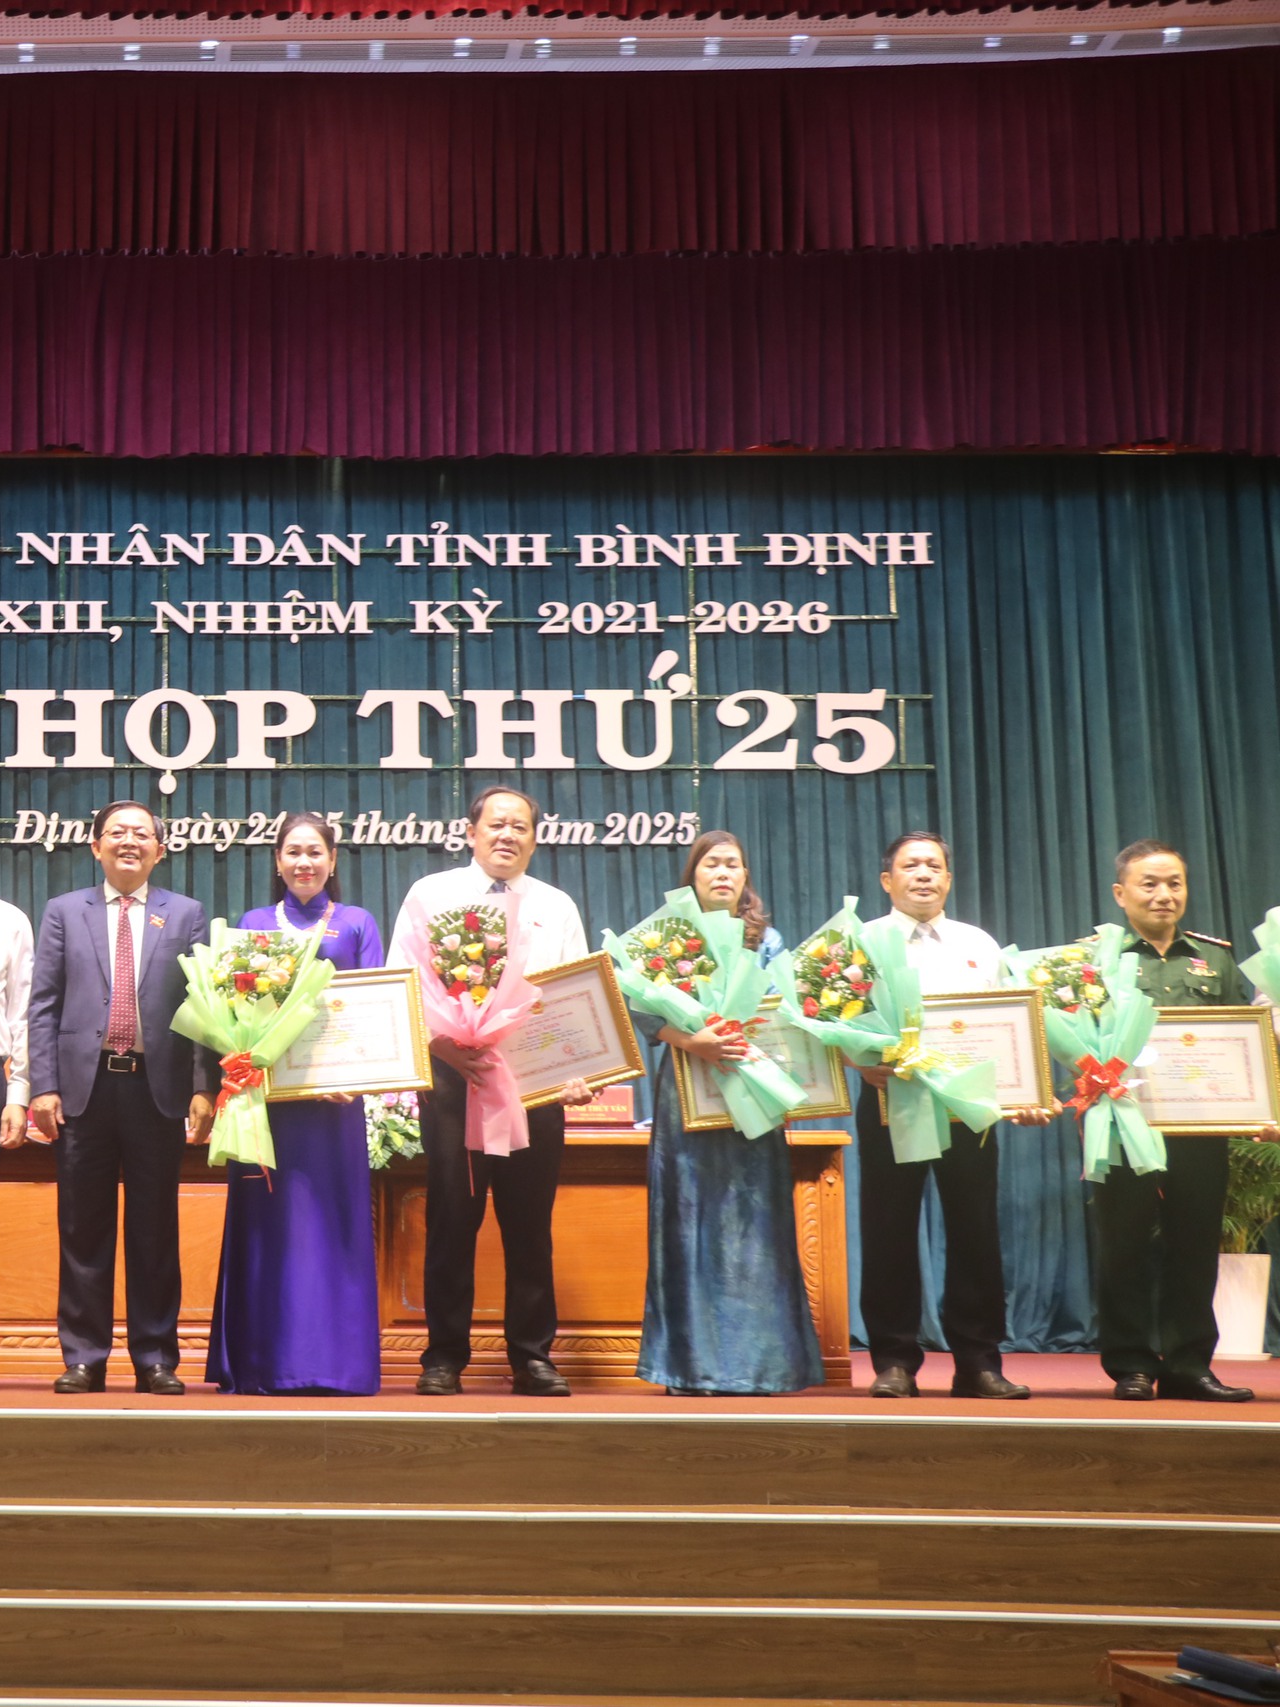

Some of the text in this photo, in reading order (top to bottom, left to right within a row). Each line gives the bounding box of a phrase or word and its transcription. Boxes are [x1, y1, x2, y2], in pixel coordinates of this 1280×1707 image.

[15, 523, 210, 566] NHÂN
[227, 524, 366, 567] DÂN
[385, 521, 553, 567] TỈNH
[574, 523, 742, 567] BÌNH
[763, 532, 935, 575] ĐỊNH
[150, 589, 374, 644] NHIỆM
[409, 587, 503, 634] KỲ
[537, 600, 831, 635] 2021-2026
[4, 687, 317, 795] HỌP
[355, 649, 693, 771] THỨ
[713, 688, 897, 775] 25
[162, 811, 240, 853] gày
[352, 810, 471, 853] tháng
[536, 812, 597, 845] ăm
[601, 811, 698, 846] 2025
